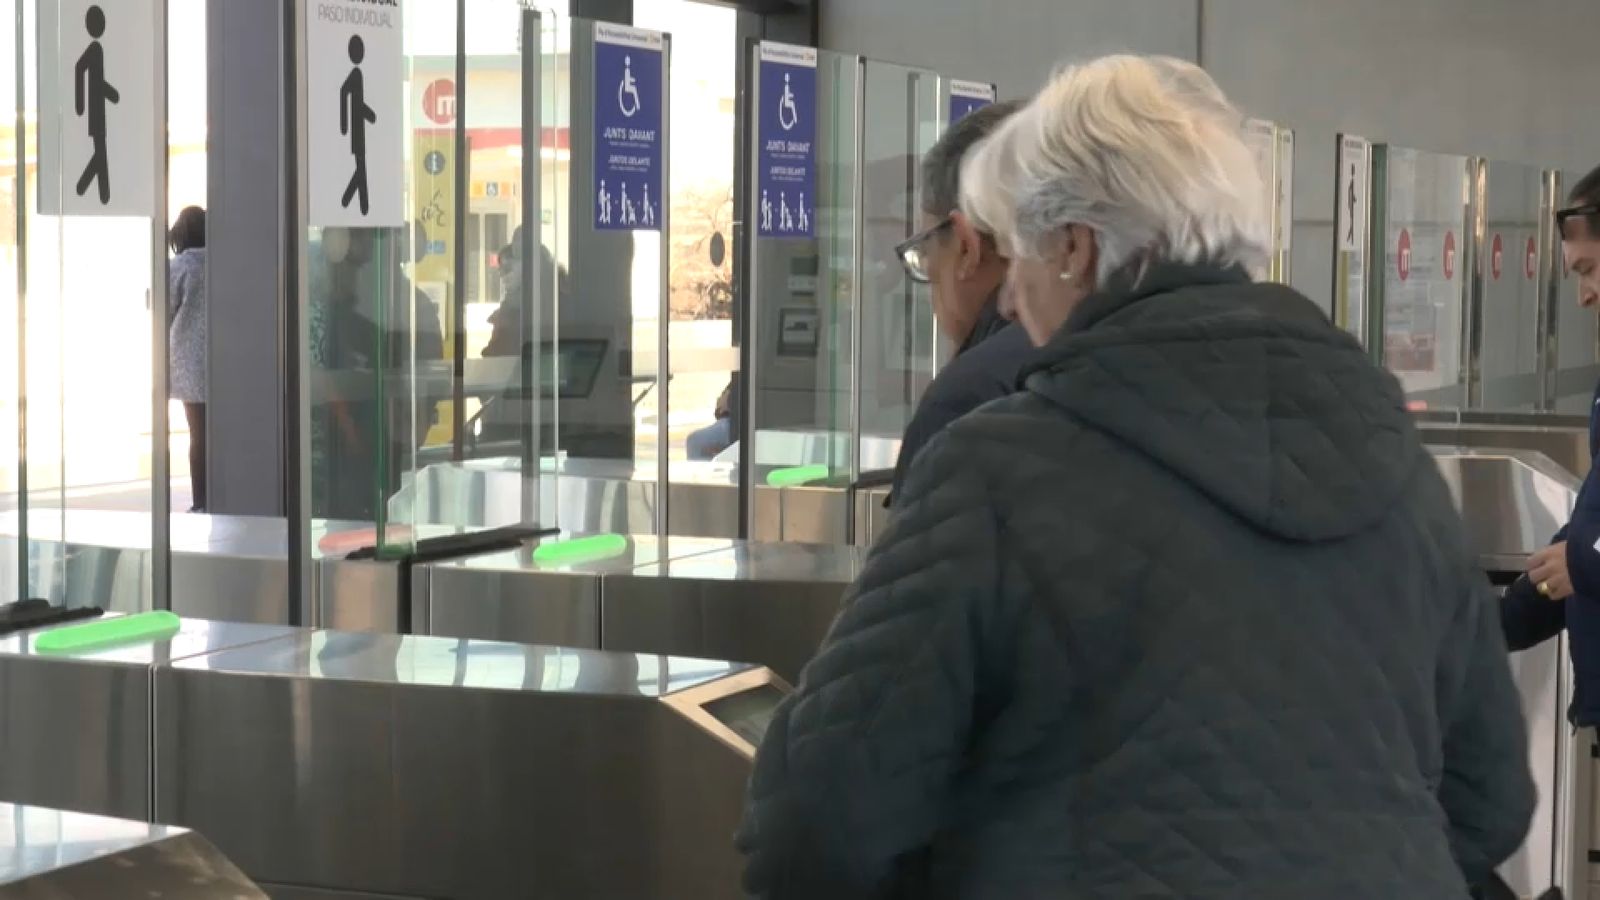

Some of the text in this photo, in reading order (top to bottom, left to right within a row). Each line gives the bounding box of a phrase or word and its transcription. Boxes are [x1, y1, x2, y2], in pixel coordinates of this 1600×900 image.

[318, 4, 393, 28] PASO INDIVIDUAL
[603, 127, 626, 140] JUNTS
